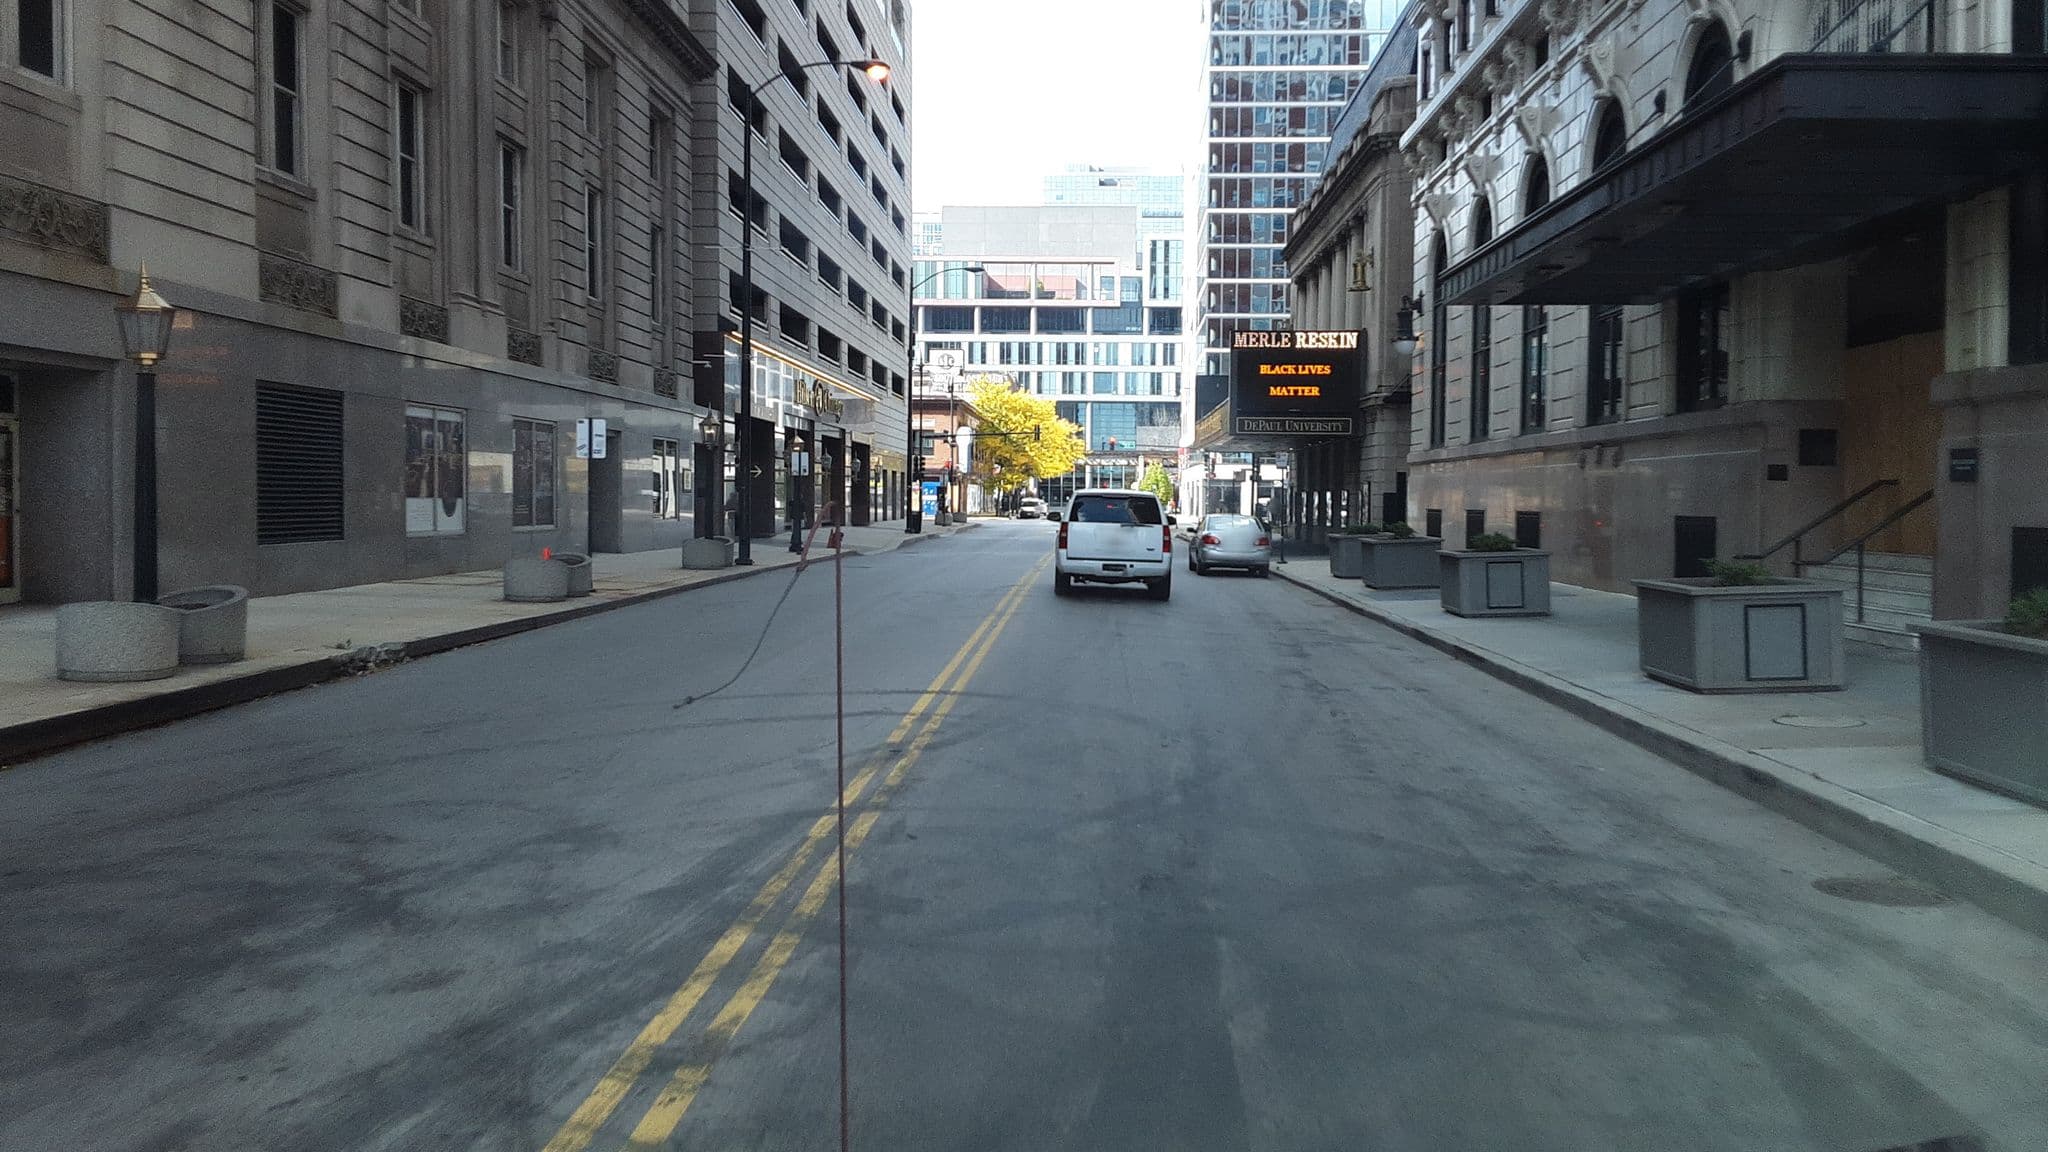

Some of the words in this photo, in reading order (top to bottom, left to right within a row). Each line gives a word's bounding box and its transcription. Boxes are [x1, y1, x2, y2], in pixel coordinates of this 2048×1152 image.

[1233, 332, 1291, 348] MERLE
[1295, 332, 1358, 348] RESKIN
[1259, 364, 1296, 375] BLACK
[1297, 365, 1332, 375] LIVES
[1269, 386, 1320, 396] MATTER
[1285, 420, 1343, 432] UNIVERSITY
